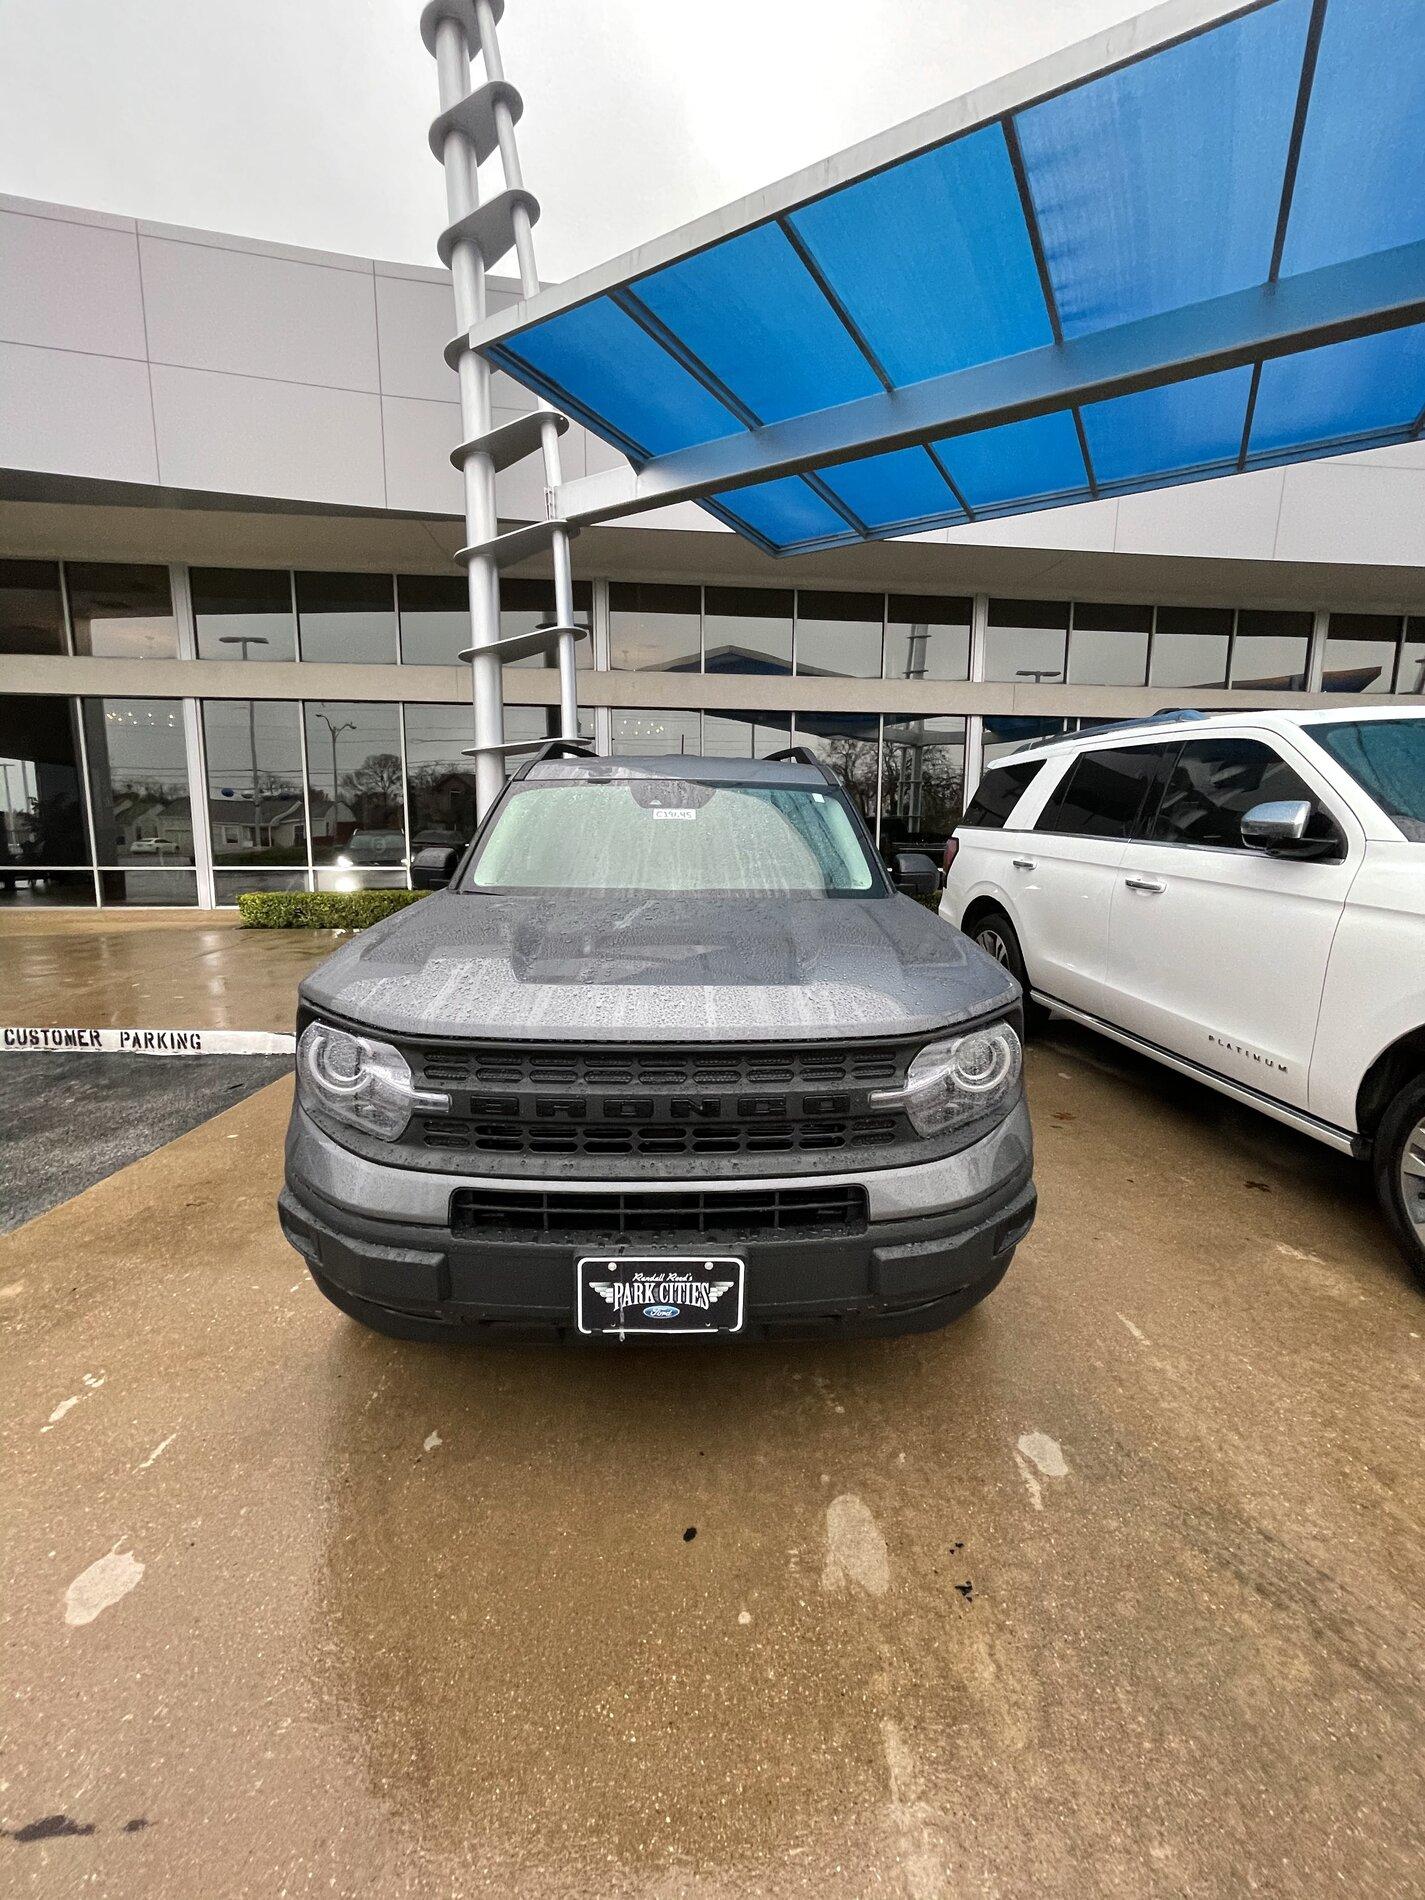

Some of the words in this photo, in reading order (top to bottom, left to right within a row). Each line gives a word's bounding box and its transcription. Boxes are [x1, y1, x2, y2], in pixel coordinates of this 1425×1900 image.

[3, 1029, 101, 1047] CUSTOMER
[120, 1032, 202, 1050] PARKING
[1208, 1034, 1288, 1073] PLATINUM
[470, 1095, 850, 1118] BRONCO
[632, 1273, 665, 1282] Randall
[613, 1282, 656, 1311] PARK
[659, 1282, 709, 1310] CITIES
[650, 1307, 673, 1317] Ford
